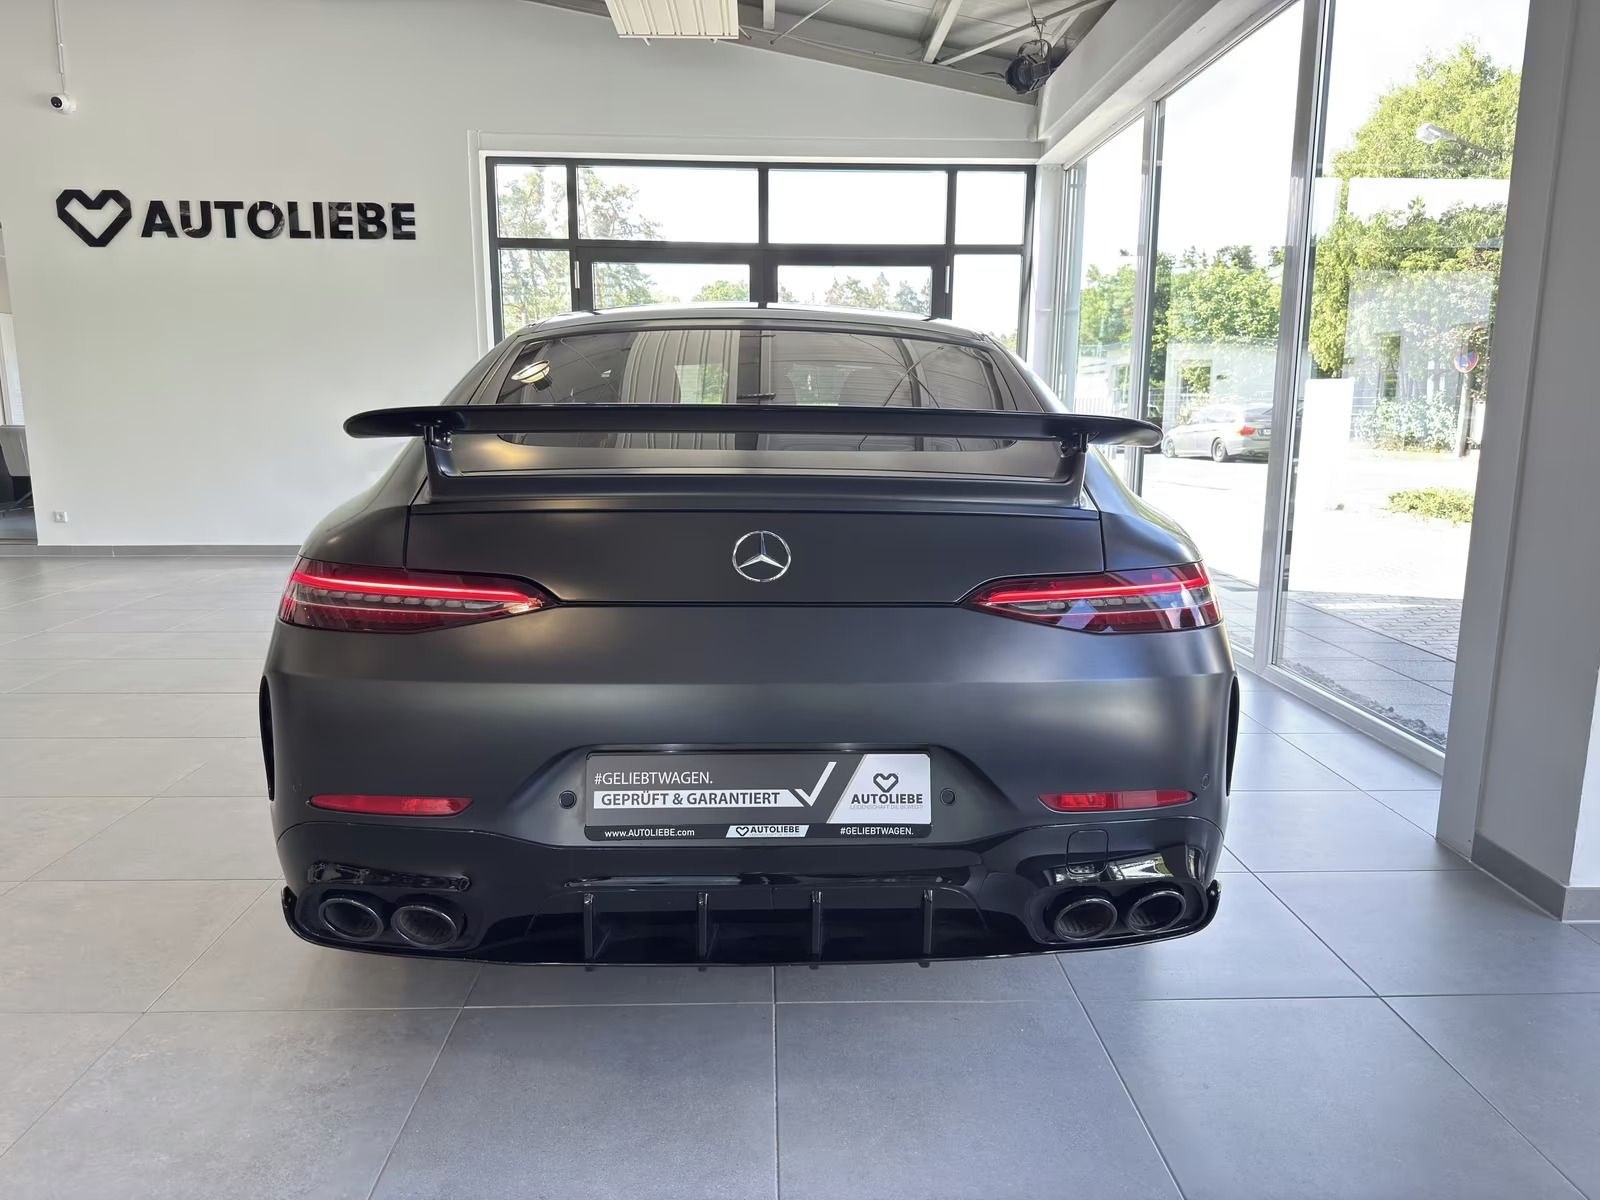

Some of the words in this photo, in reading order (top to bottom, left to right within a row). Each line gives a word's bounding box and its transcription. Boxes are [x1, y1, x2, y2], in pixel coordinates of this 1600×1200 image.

[140, 200, 417, 240] AUTOLIEBE
[594, 771, 713, 785] #GELIEBTWAGEN.
[601, 790, 669, 806] GEPRÜFT
[672, 793, 684, 805] &
[686, 791, 781, 805] GARANTIERT
[851, 794, 923, 804] AUTOLIEBE
[604, 828, 695, 837] www.AUTOLIEBE.com
[750, 825, 800, 833] AUTOLIEBE
[840, 826, 914, 835] #GELIEBTWAGEN.
